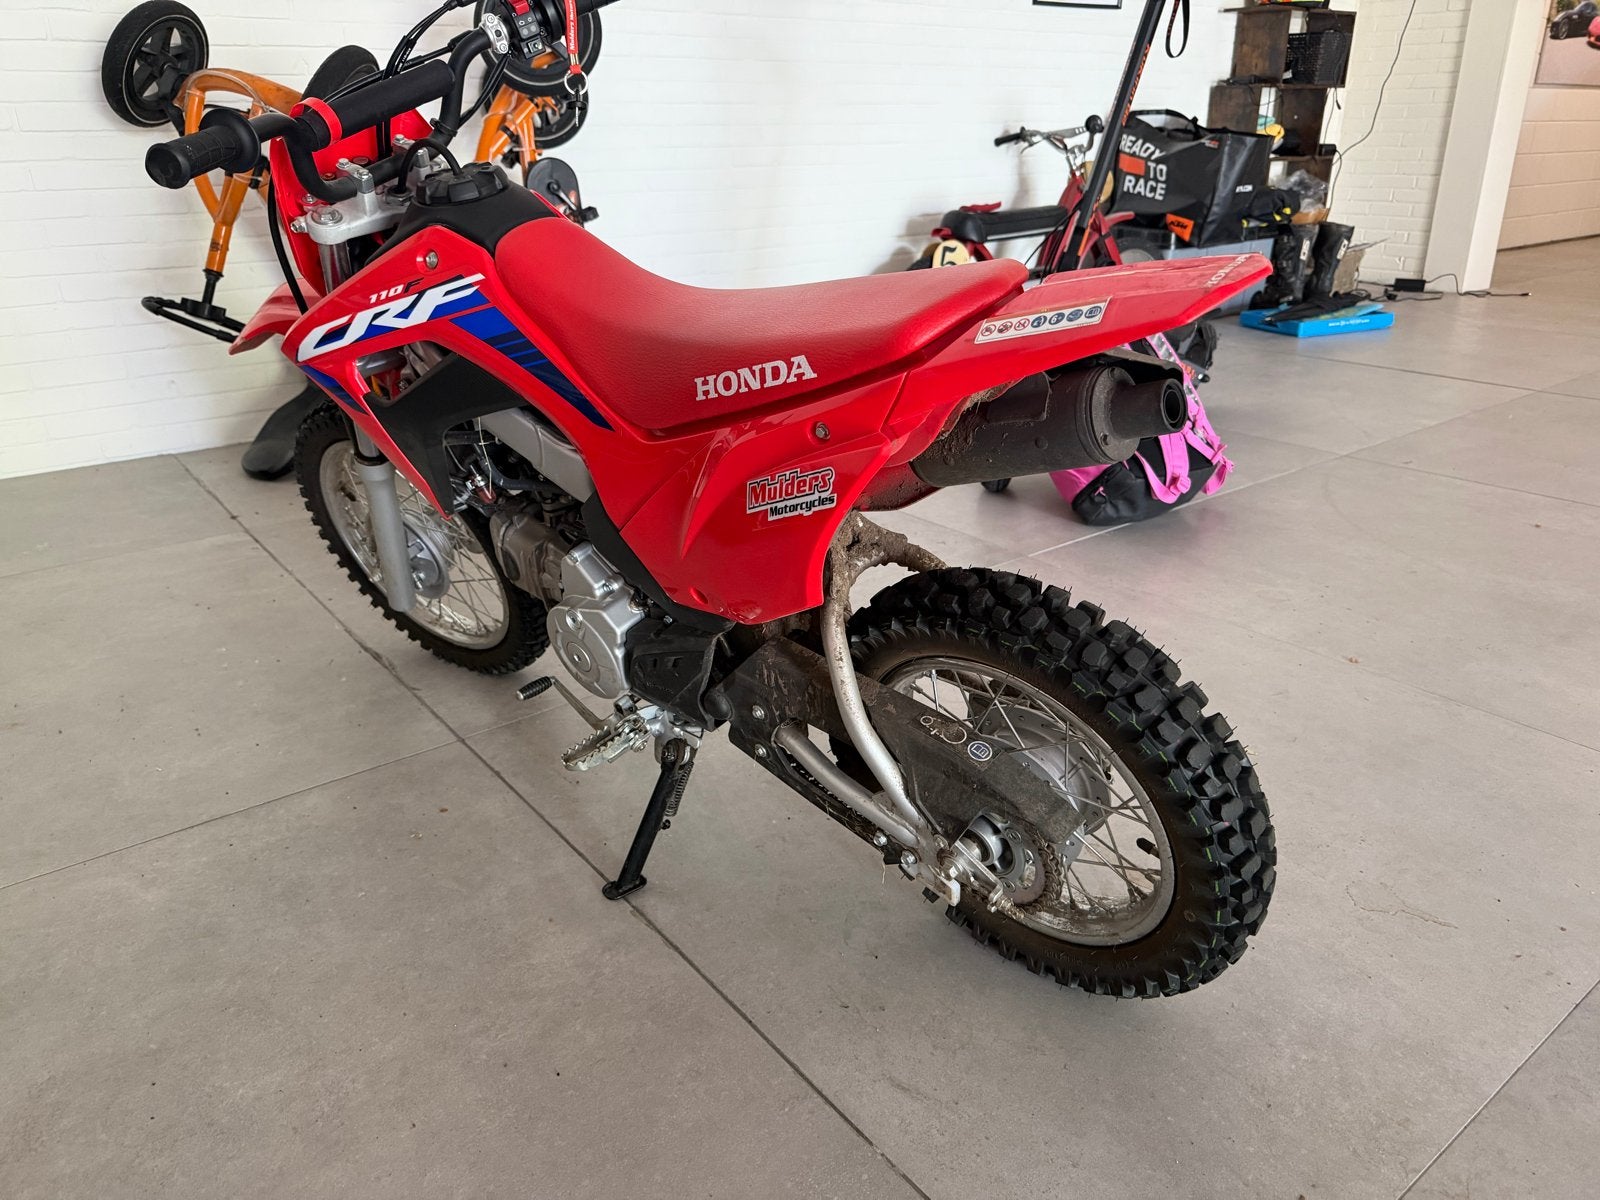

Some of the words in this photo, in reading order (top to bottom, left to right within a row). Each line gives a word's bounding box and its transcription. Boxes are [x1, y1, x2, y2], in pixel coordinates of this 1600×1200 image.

[1119, 133, 1167, 161] READY
[1147, 161, 1167, 182] TO
[1123, 174, 1167, 201] RACE
[369, 277, 424, 304] 110F
[298, 273, 486, 362] CRF
[694, 354, 818, 401] HONDA
[747, 467, 834, 511] Mulders
[769, 494, 836, 519] Motorcycles
